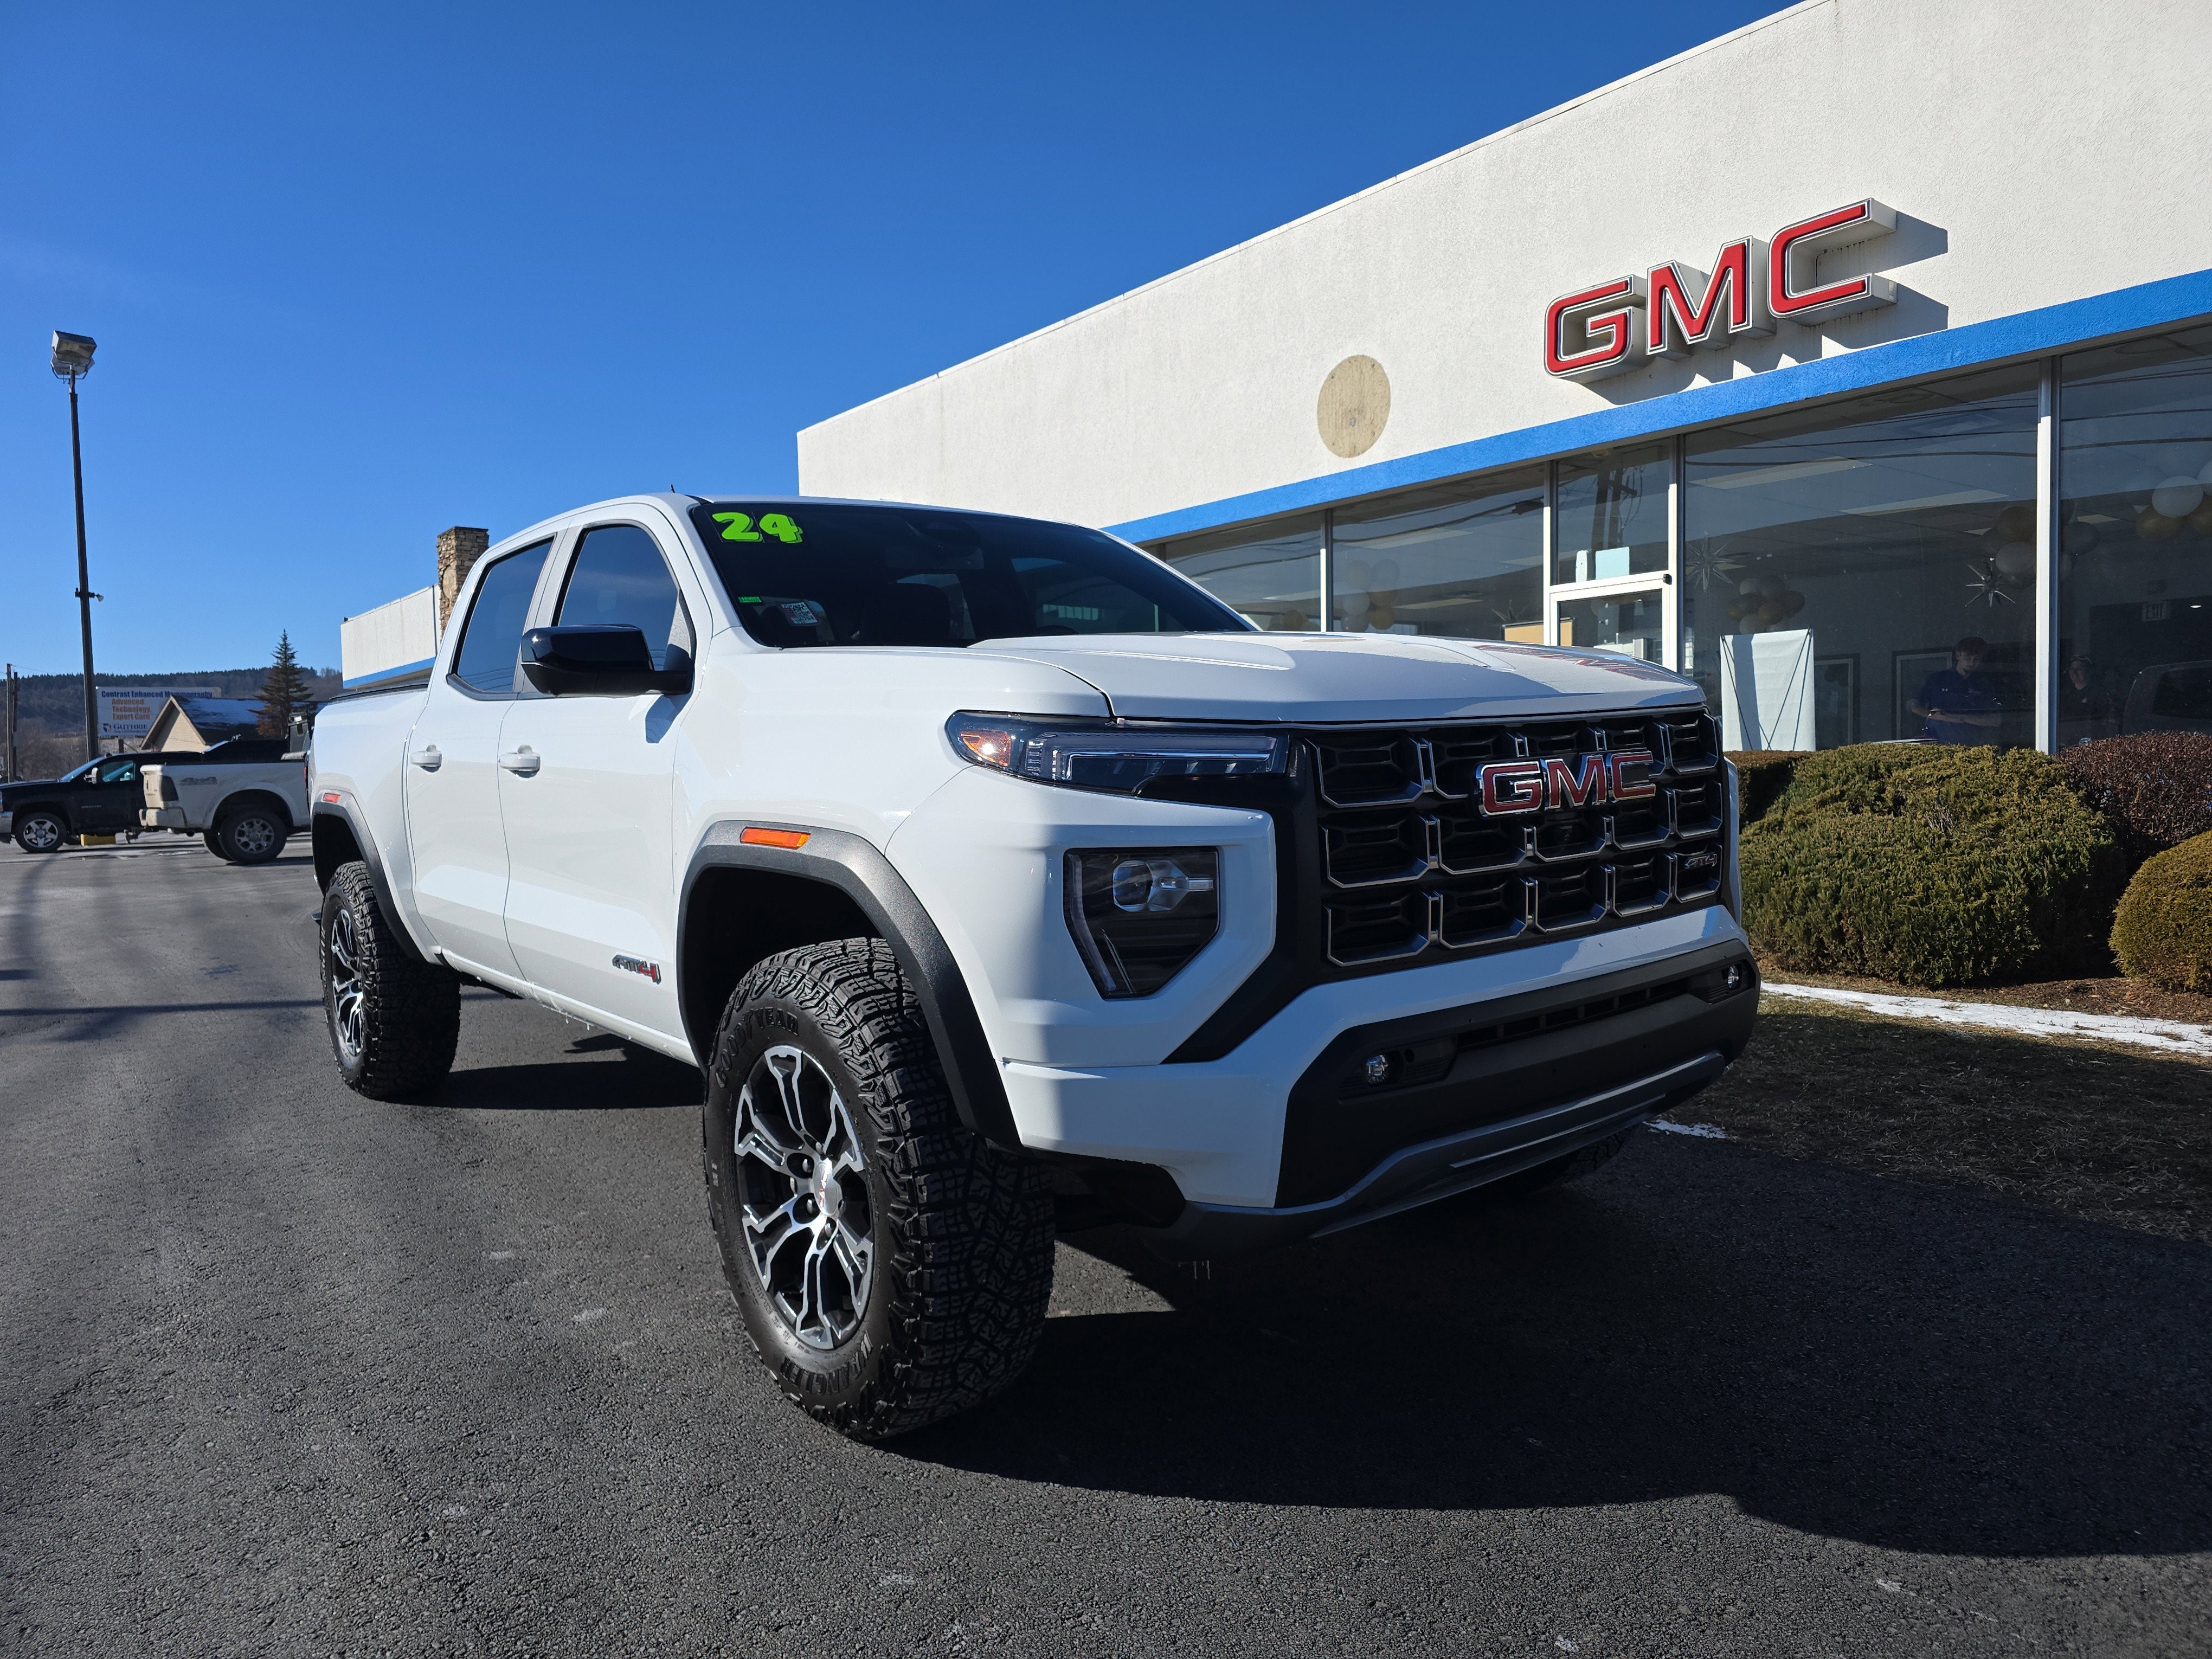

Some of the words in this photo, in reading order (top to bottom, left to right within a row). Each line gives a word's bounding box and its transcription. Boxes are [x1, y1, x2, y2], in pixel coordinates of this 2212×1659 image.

[1544, 197, 1872, 378] GMC
[712, 512, 803, 543] 24
[1478, 750, 1656, 816] GMC
[716, 1006, 799, 1088] GOODYEAR
[780, 1329, 873, 1396] WRANGLER
